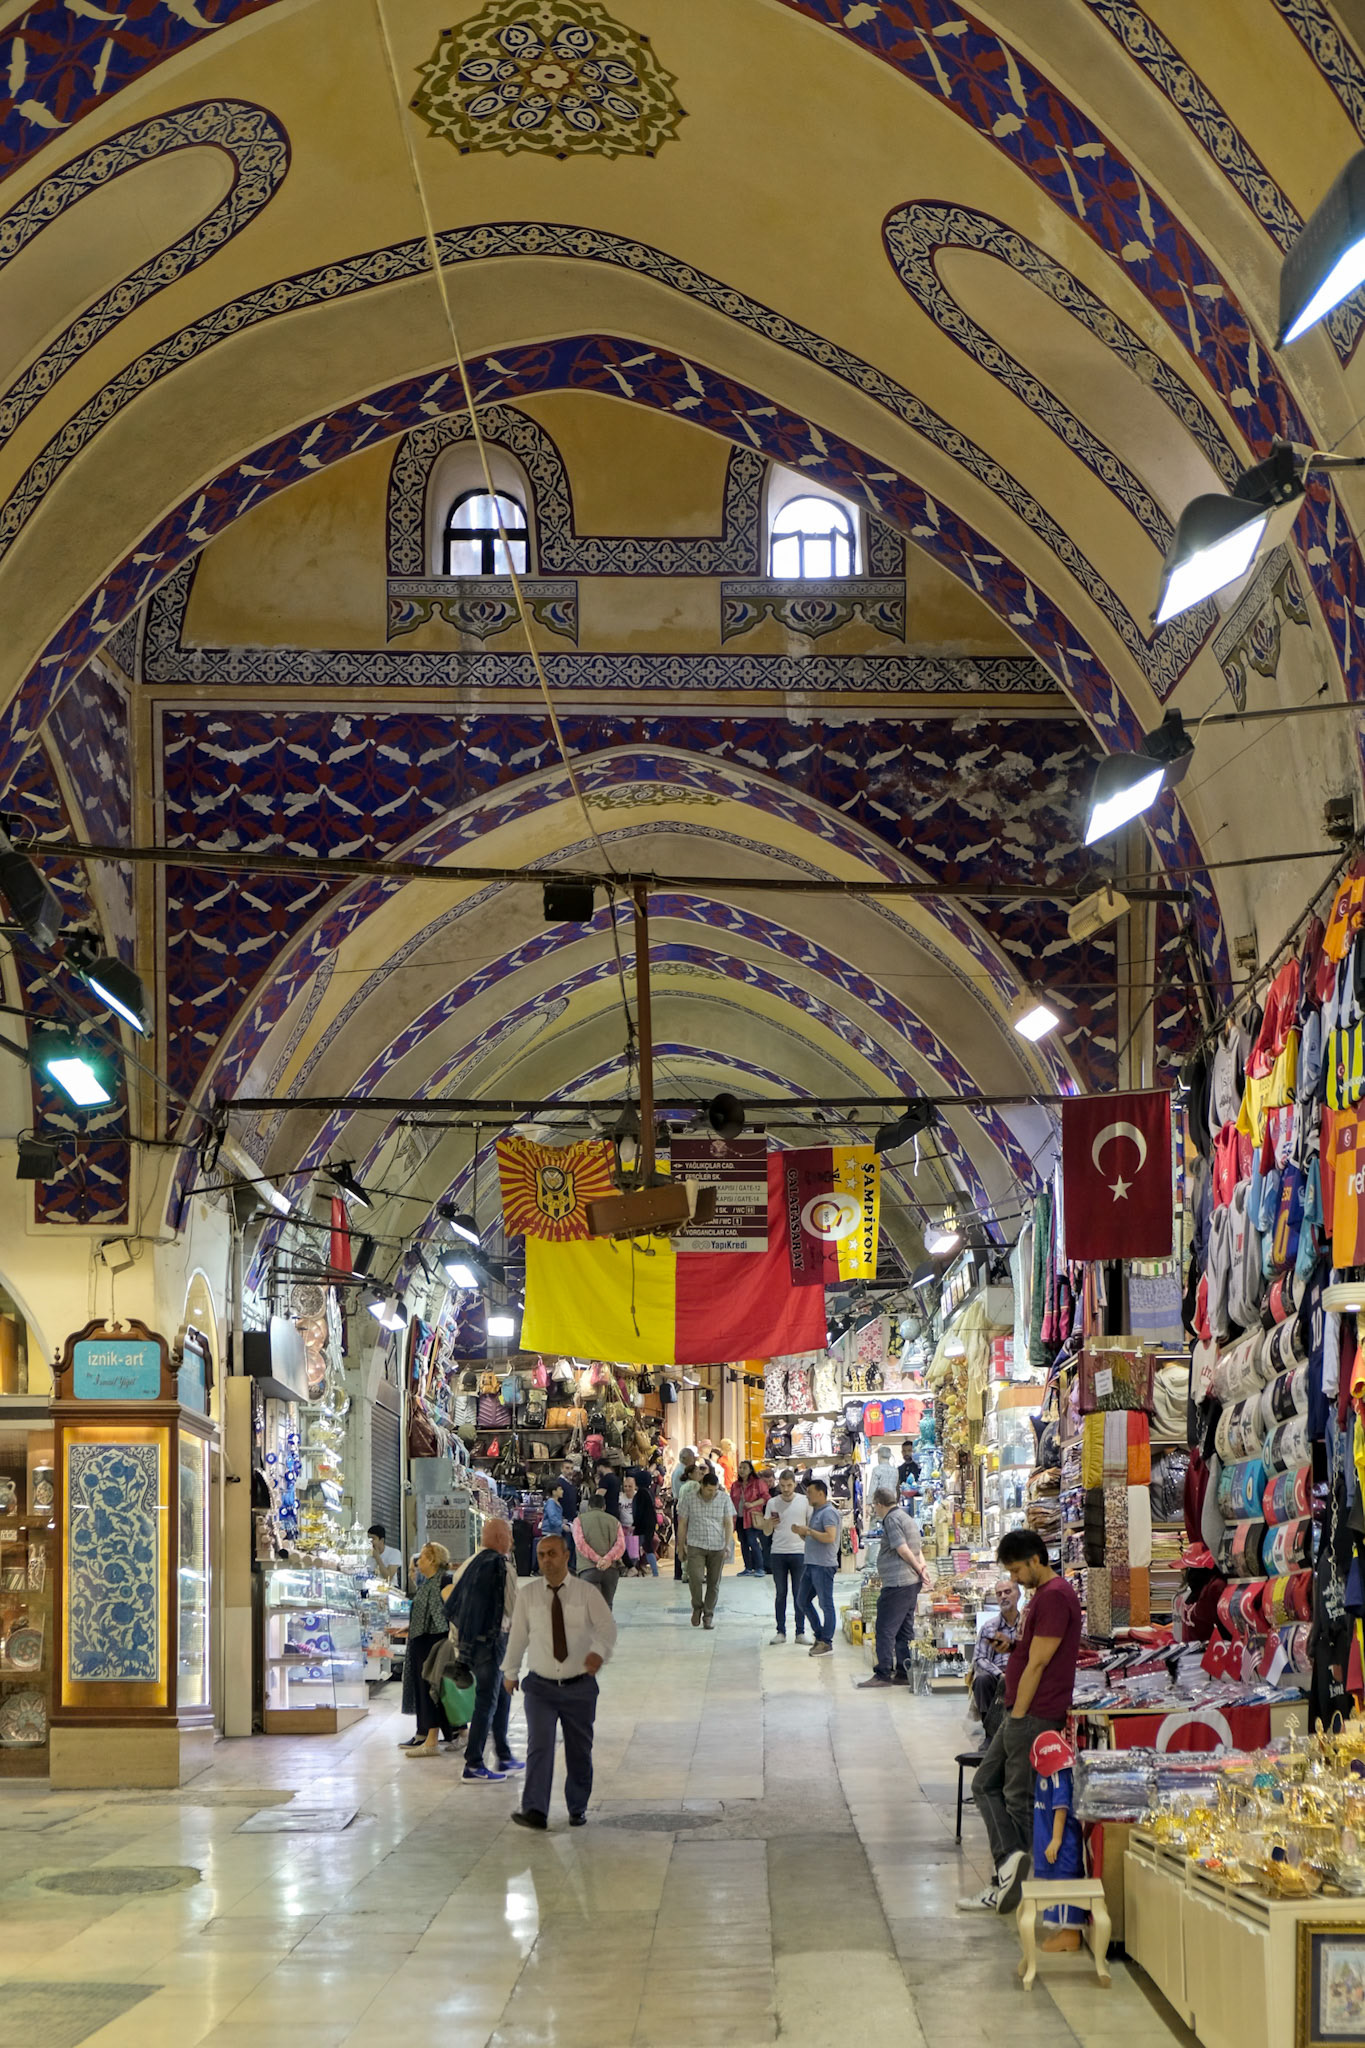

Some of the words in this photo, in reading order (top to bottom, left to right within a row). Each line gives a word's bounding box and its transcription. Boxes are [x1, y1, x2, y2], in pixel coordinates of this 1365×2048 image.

[685, 1161, 720, 1170] YAĞLIKÇILAR
[787, 1167, 805, 1271] GALATASARAY
[861, 1162, 876, 1264] ŞAMPİYON
[88, 1351, 144, 1366] iznik-art
